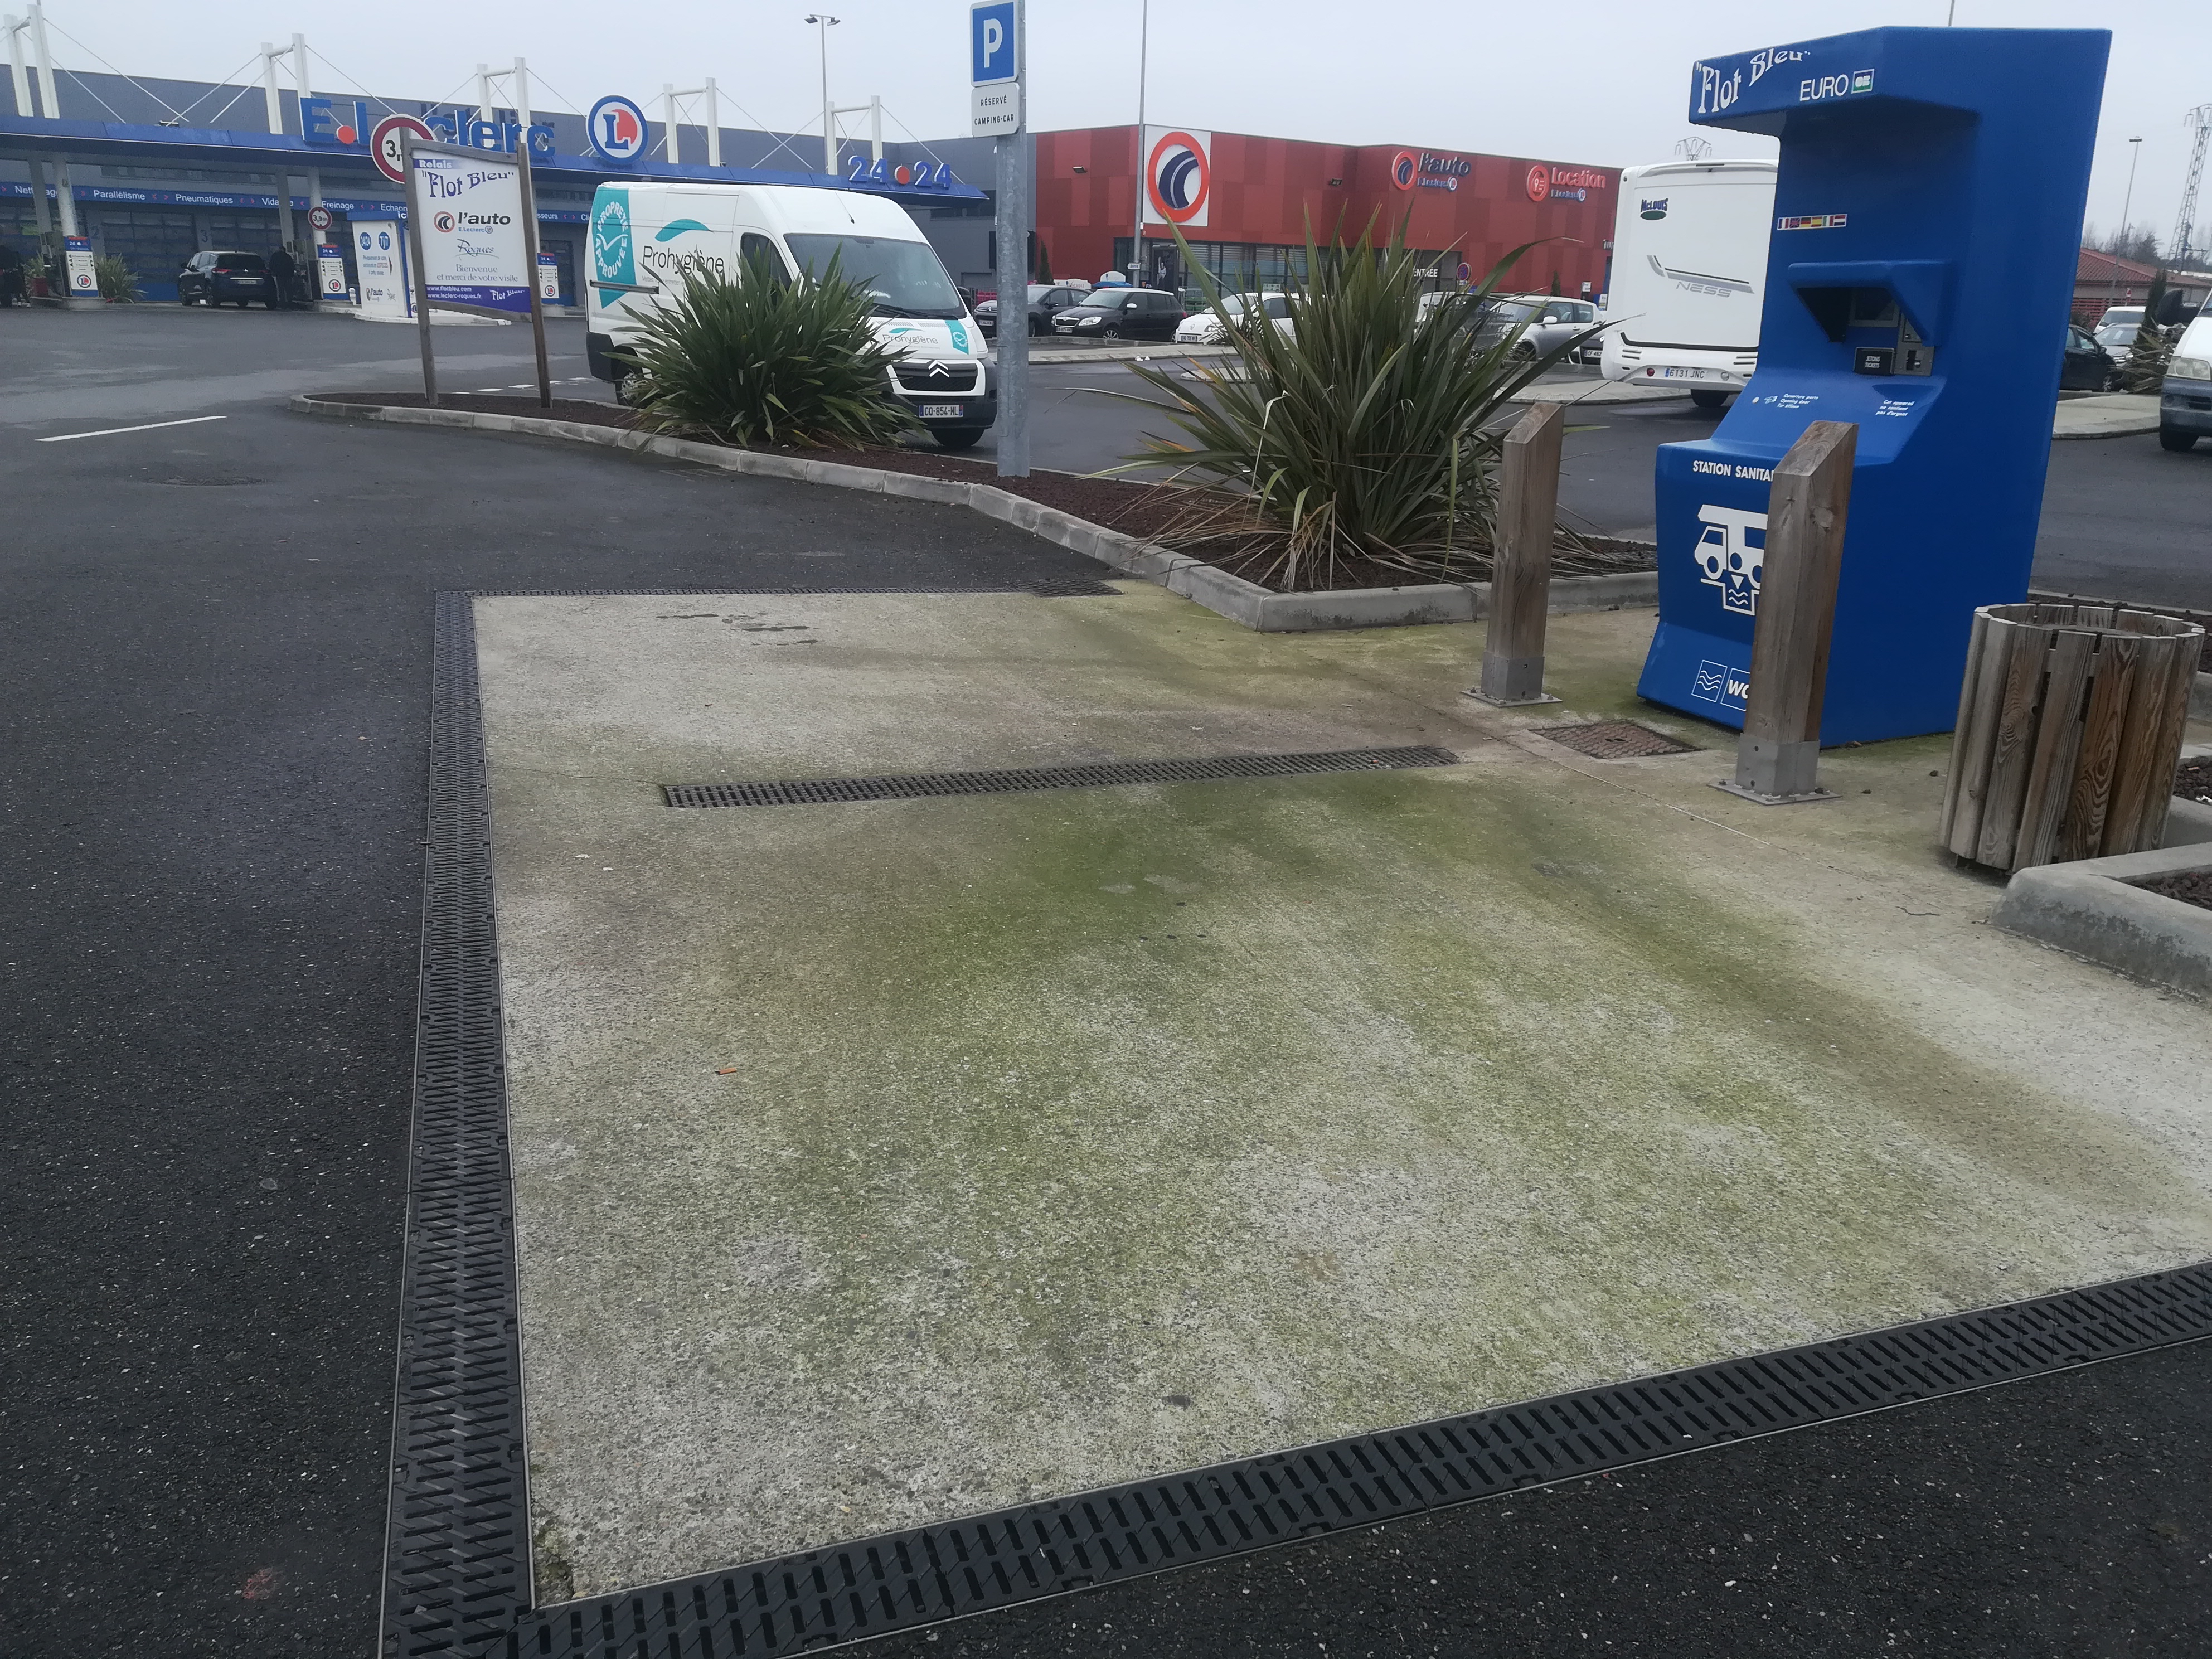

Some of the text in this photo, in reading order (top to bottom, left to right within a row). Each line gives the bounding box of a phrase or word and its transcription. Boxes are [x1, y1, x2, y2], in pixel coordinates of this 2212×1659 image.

[983, 18, 1003, 68] P
[1800, 74, 1849, 101] EURO
[981, 94, 1007, 106] RÉSERVÉ
[974, 114, 1014, 125] CAMPING-CAR
[419, 159, 452, 168] Relais
[848, 155, 952, 188] 24 24
[1418, 152, 1472, 177] l'auto
[1551, 167, 1607, 188] Location
[93, 190, 145, 200] Parallélisme
[176, 193, 234, 205] Pneumatiques
[261, 197, 294, 206] Vidae
[321, 201, 355, 211] Freinage
[458, 212, 511, 225] l'auto
[457, 238, 494, 257] Roques
[596, 237, 628, 278] APPROUVÉE
[643, 245, 724, 277] Prohygiène
[456, 264, 498, 273] Bienvenue
[1676, 281, 1732, 298] NESS
[882, 334, 938, 345] Prohygiène
[1669, 368, 1705, 379] 6131 JNC
[1693, 460, 1731, 476] STATION
[1728, 679, 1749, 699] WC
